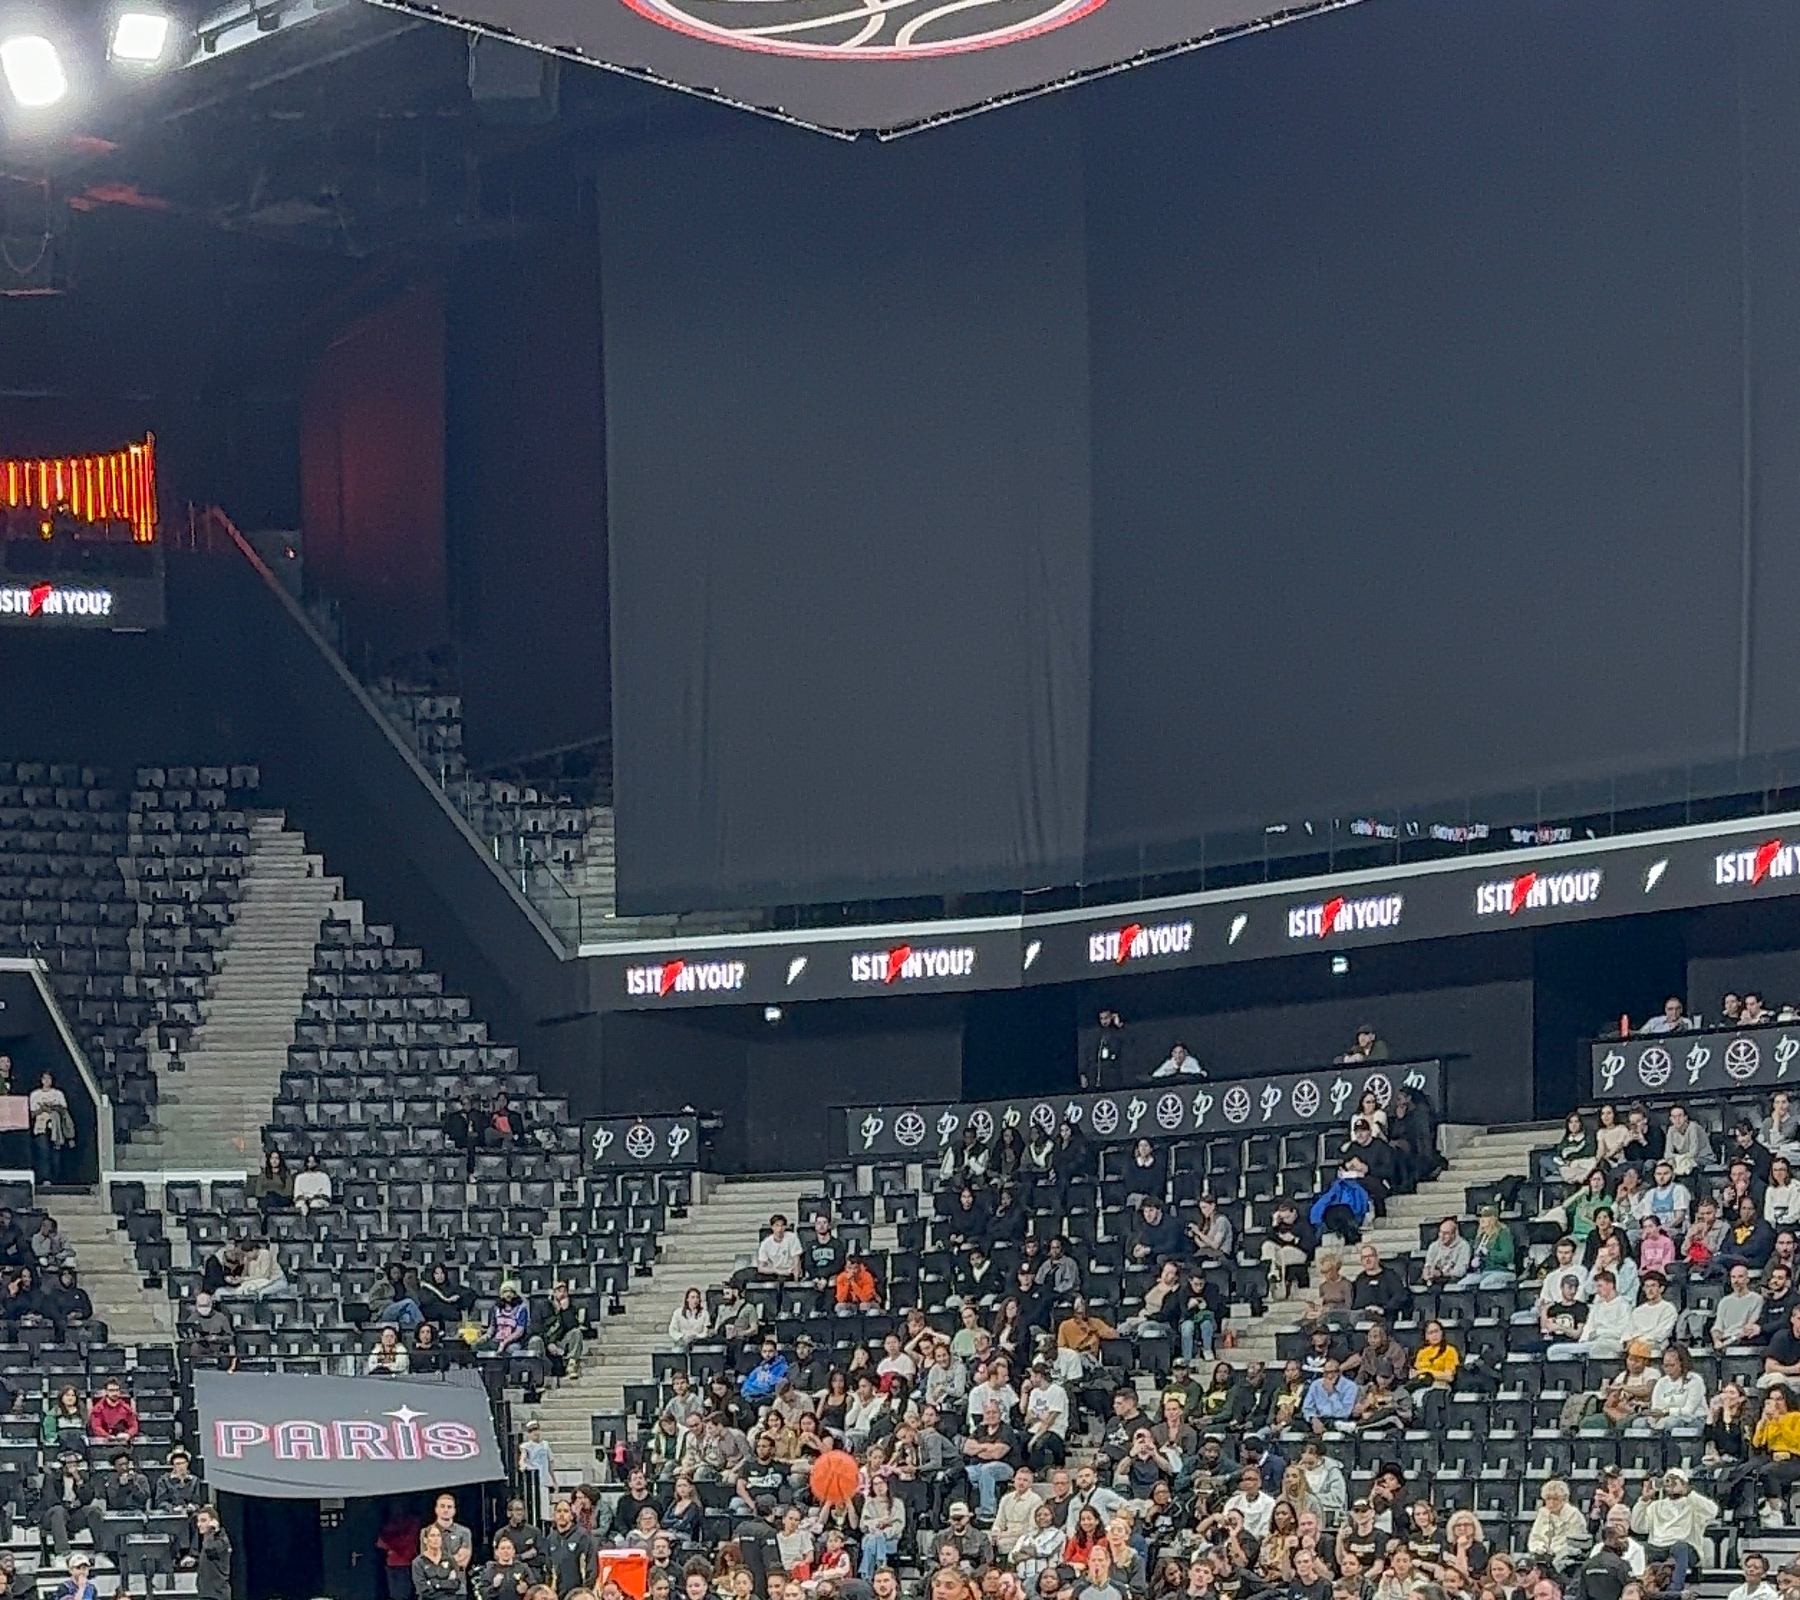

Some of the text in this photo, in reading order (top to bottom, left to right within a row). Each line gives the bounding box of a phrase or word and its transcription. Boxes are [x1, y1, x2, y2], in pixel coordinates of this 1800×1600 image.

[63, 590, 112, 615] YOU?
[1547, 872, 1600, 905] YOU?
[1353, 896, 1402, 930] YOU?
[1148, 921, 1192, 954] YOU?
[695, 961, 745, 990] YOU?
[922, 948, 974, 976] YOU?
